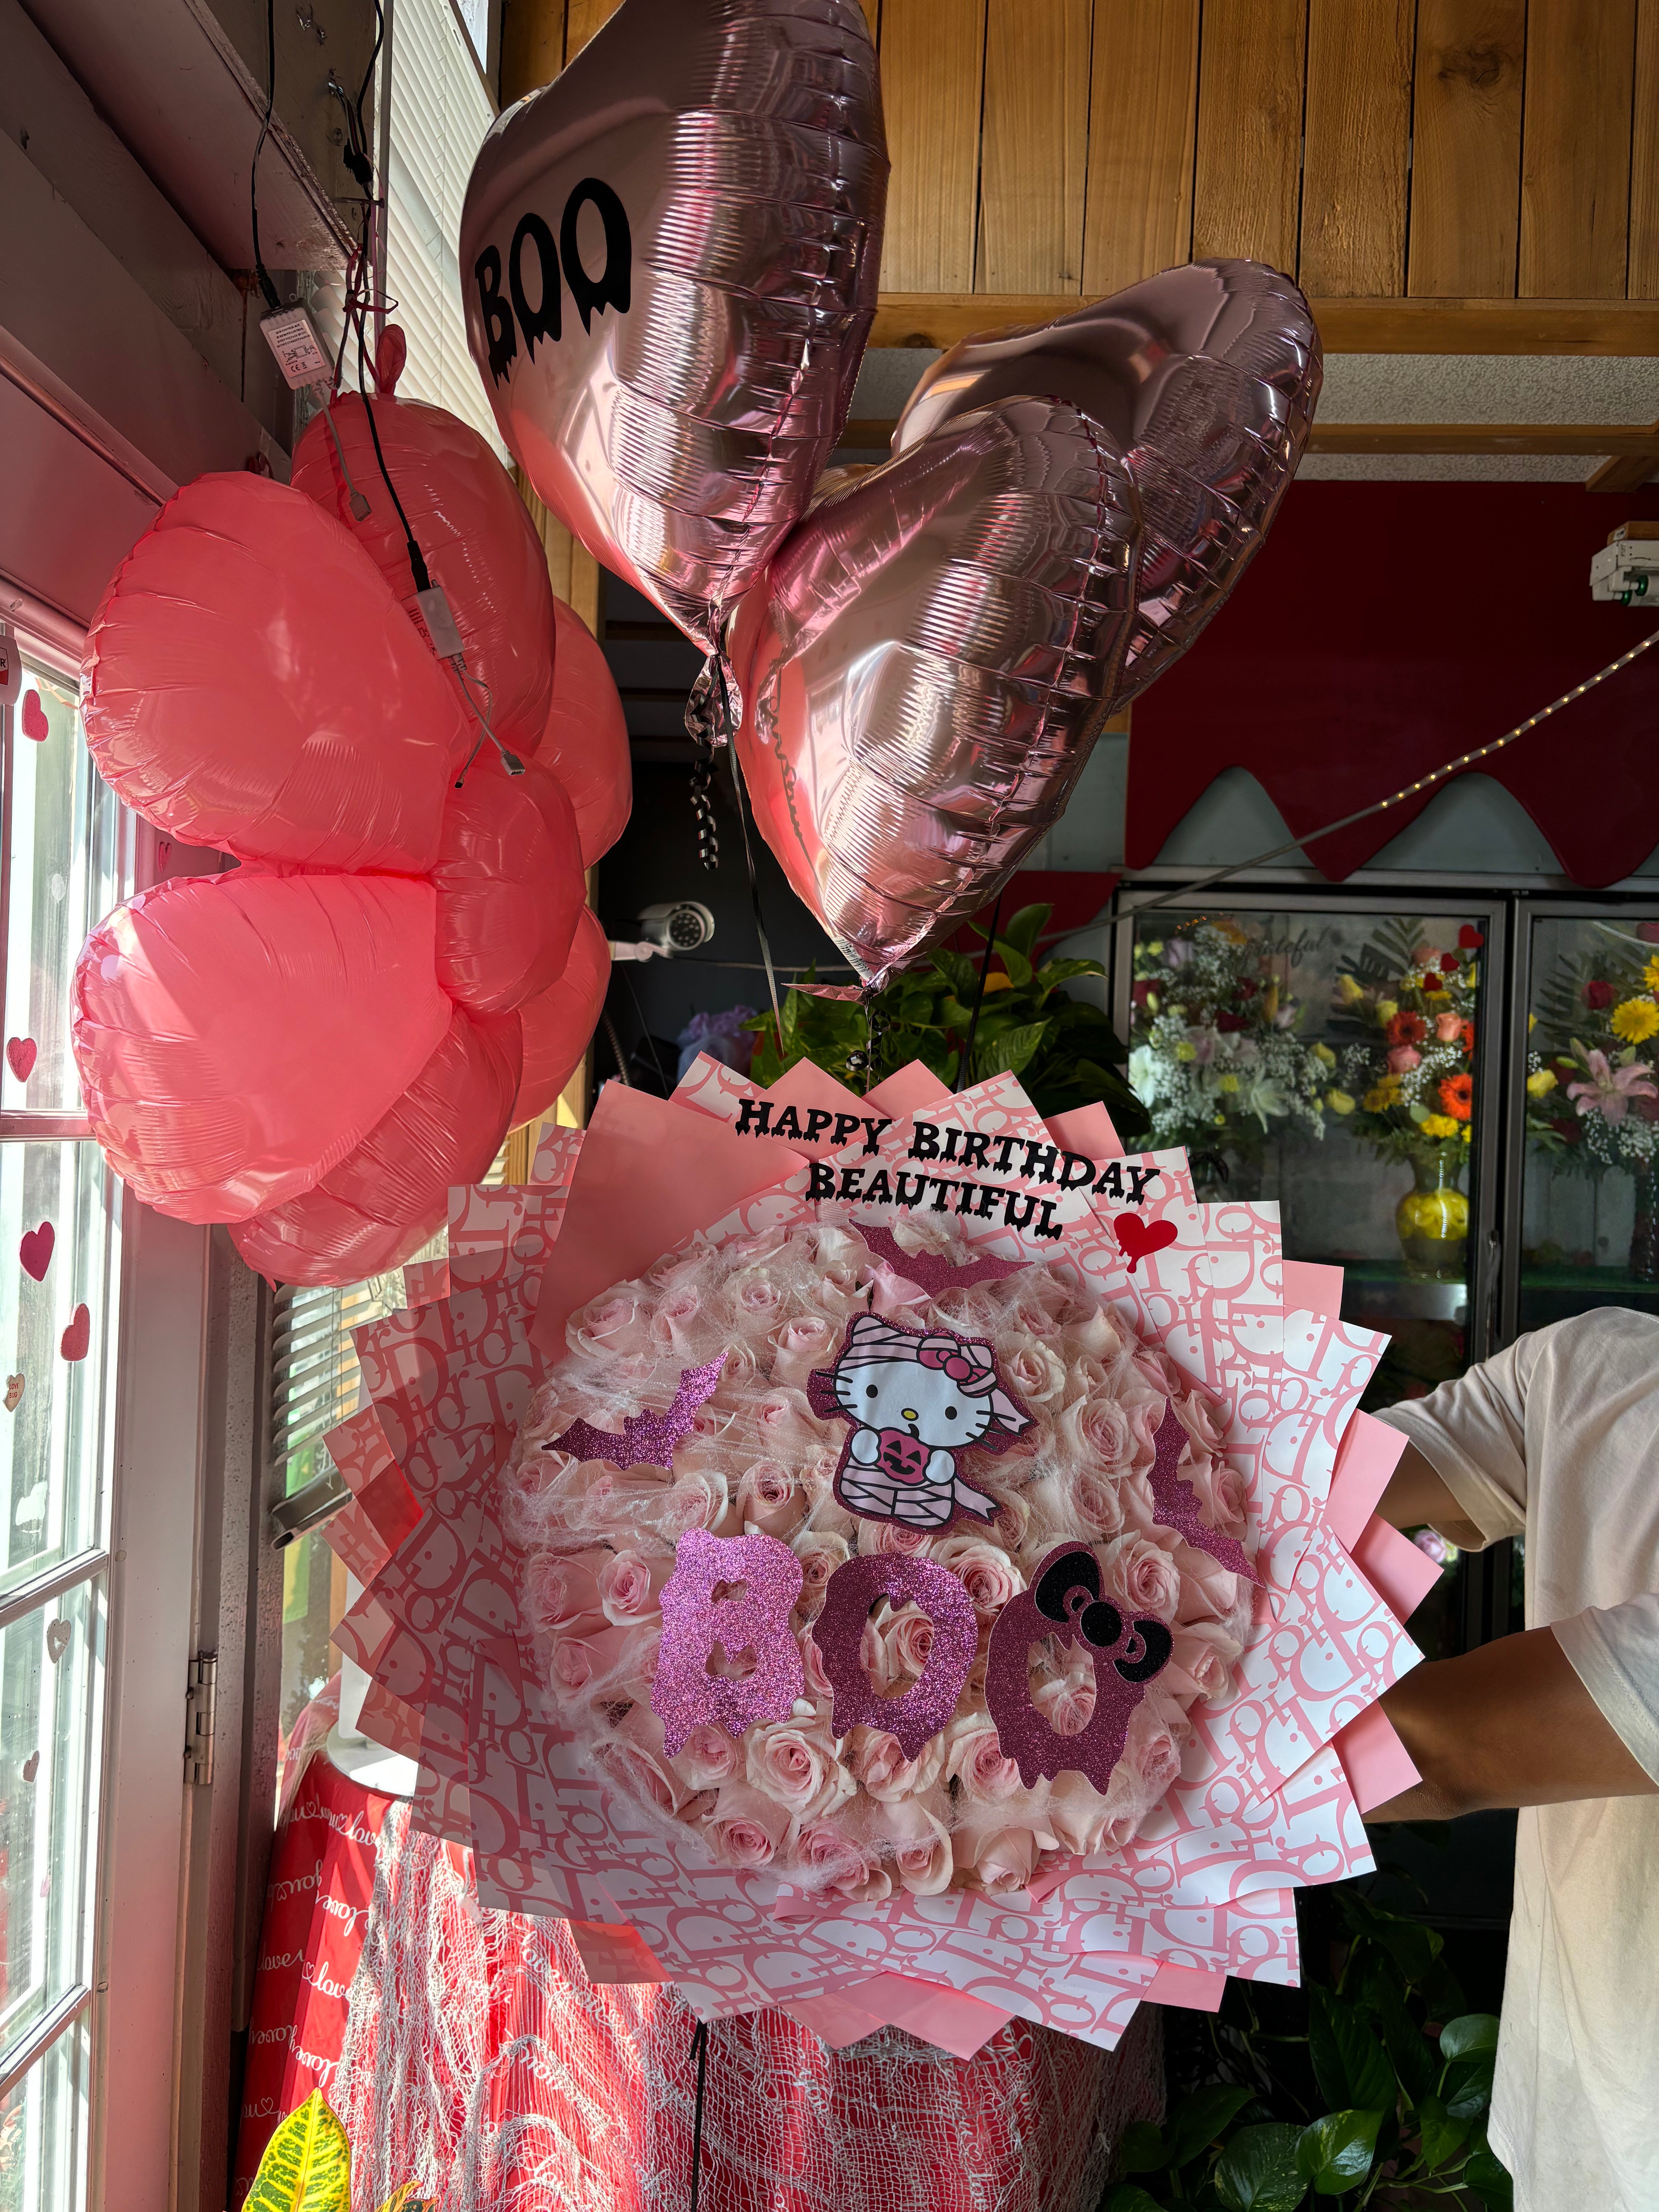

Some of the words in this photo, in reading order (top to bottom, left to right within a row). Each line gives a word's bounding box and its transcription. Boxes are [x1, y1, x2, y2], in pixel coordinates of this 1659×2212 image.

[475, 178, 632, 391] BOO
[735, 1098, 893, 1156] HAPPY
[908, 1121, 1160, 1205] BIRTHDAY
[805, 1162, 1063, 1240] BEAUTIFUL
[381, 1337, 471, 1434] Dior
[651, 1528, 1174, 1796] BOO
[1264, 1614, 1369, 1702] Dior
